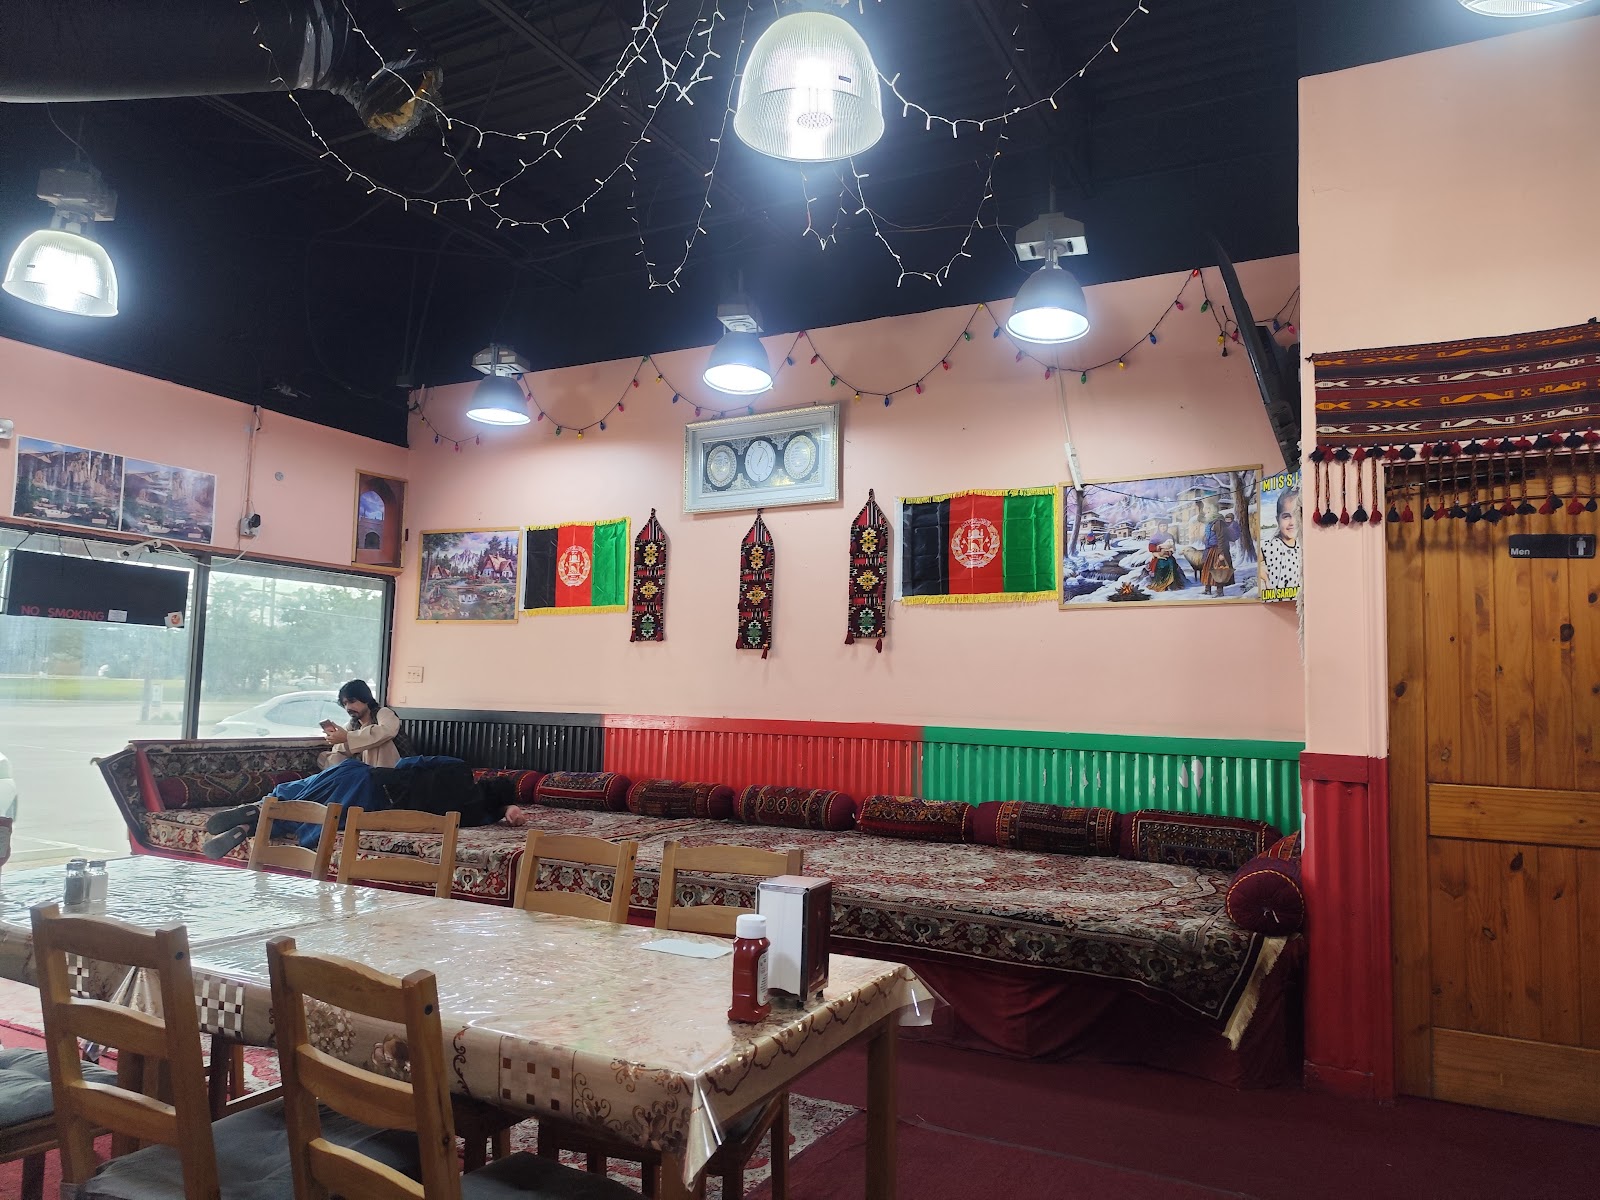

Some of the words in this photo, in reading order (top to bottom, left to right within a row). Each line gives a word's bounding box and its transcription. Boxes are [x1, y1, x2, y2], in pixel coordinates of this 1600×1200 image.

[1510, 548, 1531, 556] Men
[1262, 589, 1276, 600] LINA
[21, 605, 40, 616] NO
[47, 607, 105, 620] SMOKING
